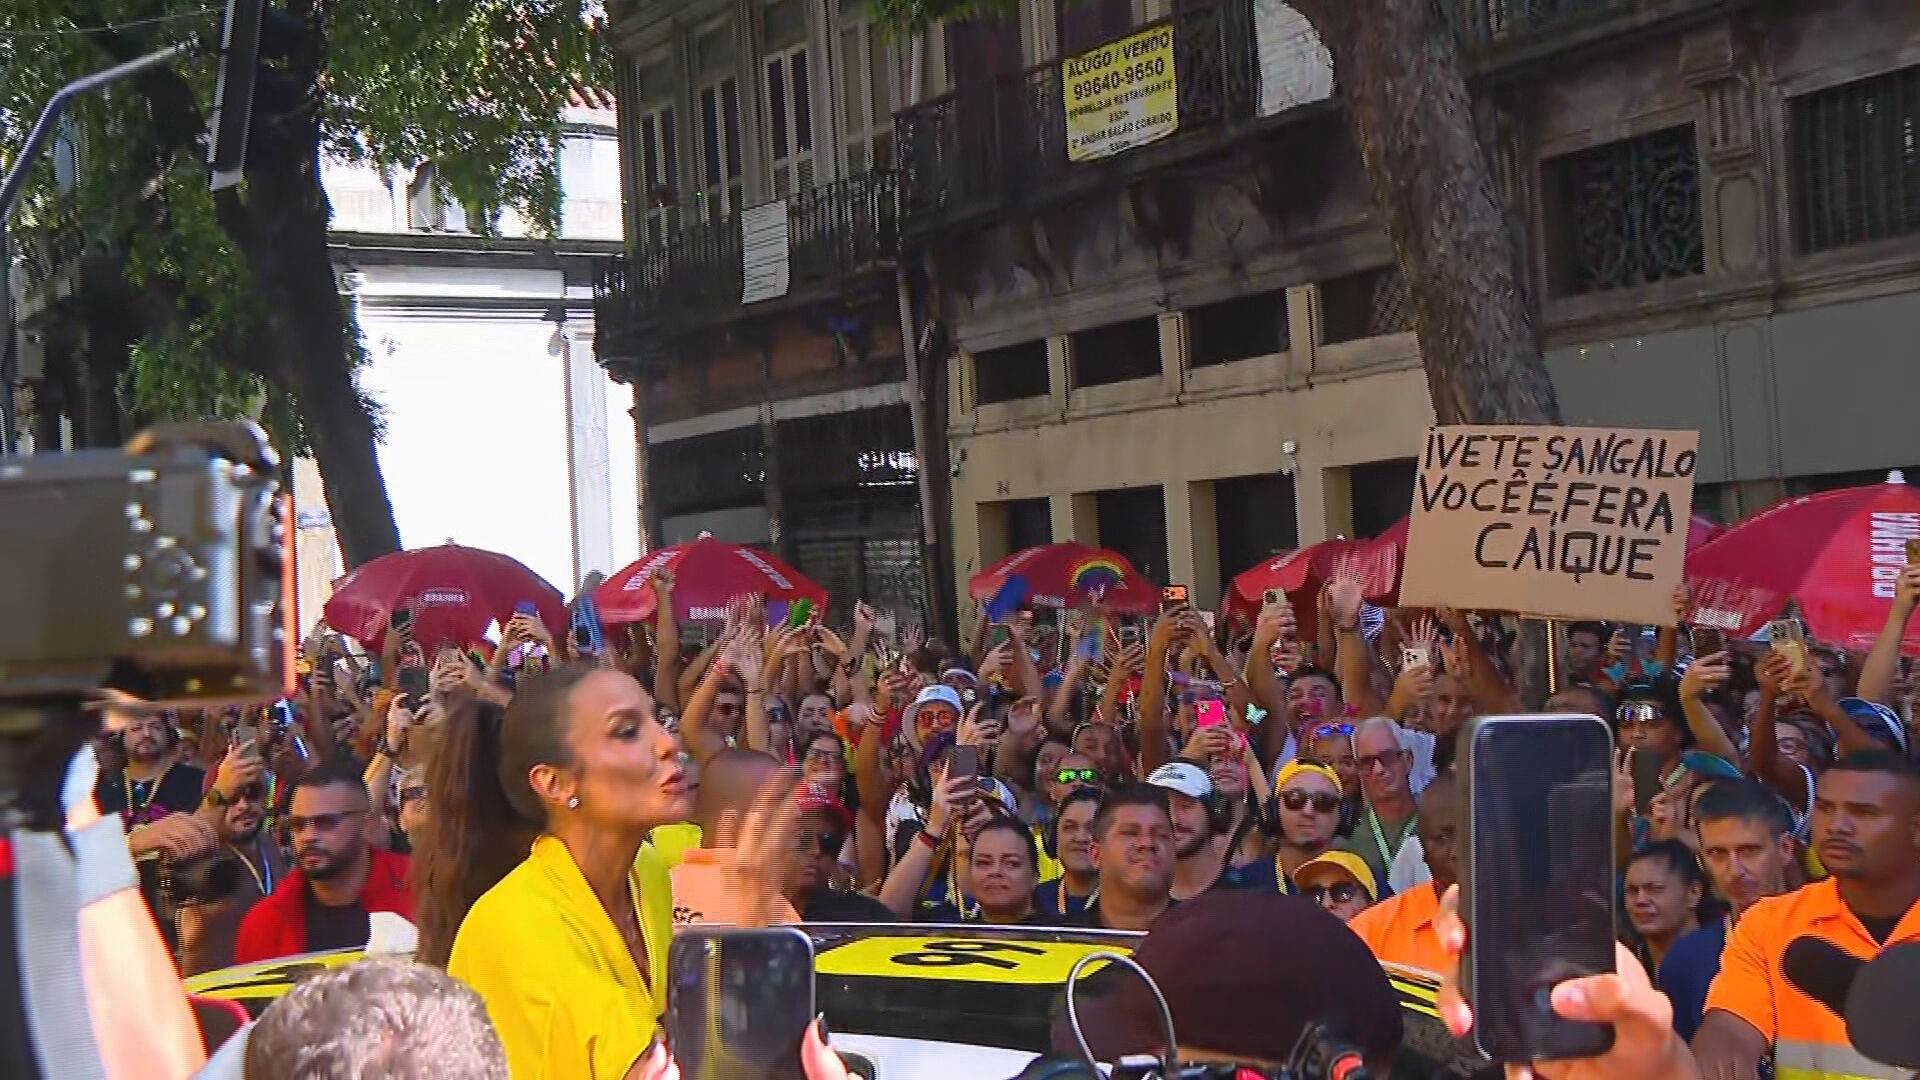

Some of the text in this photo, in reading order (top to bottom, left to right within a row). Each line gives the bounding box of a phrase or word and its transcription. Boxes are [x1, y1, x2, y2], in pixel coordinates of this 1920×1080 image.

[1068, 51, 1112, 79] ALUGO
[1122, 31, 1170, 61] VENDO
[1073, 57, 1165, 100] 99640-9650
[1543, 433, 1697, 479] SANGALO
[1419, 469, 1675, 534] VOCÊ É FERA
[1693, 606, 1744, 631] BRAHMA
